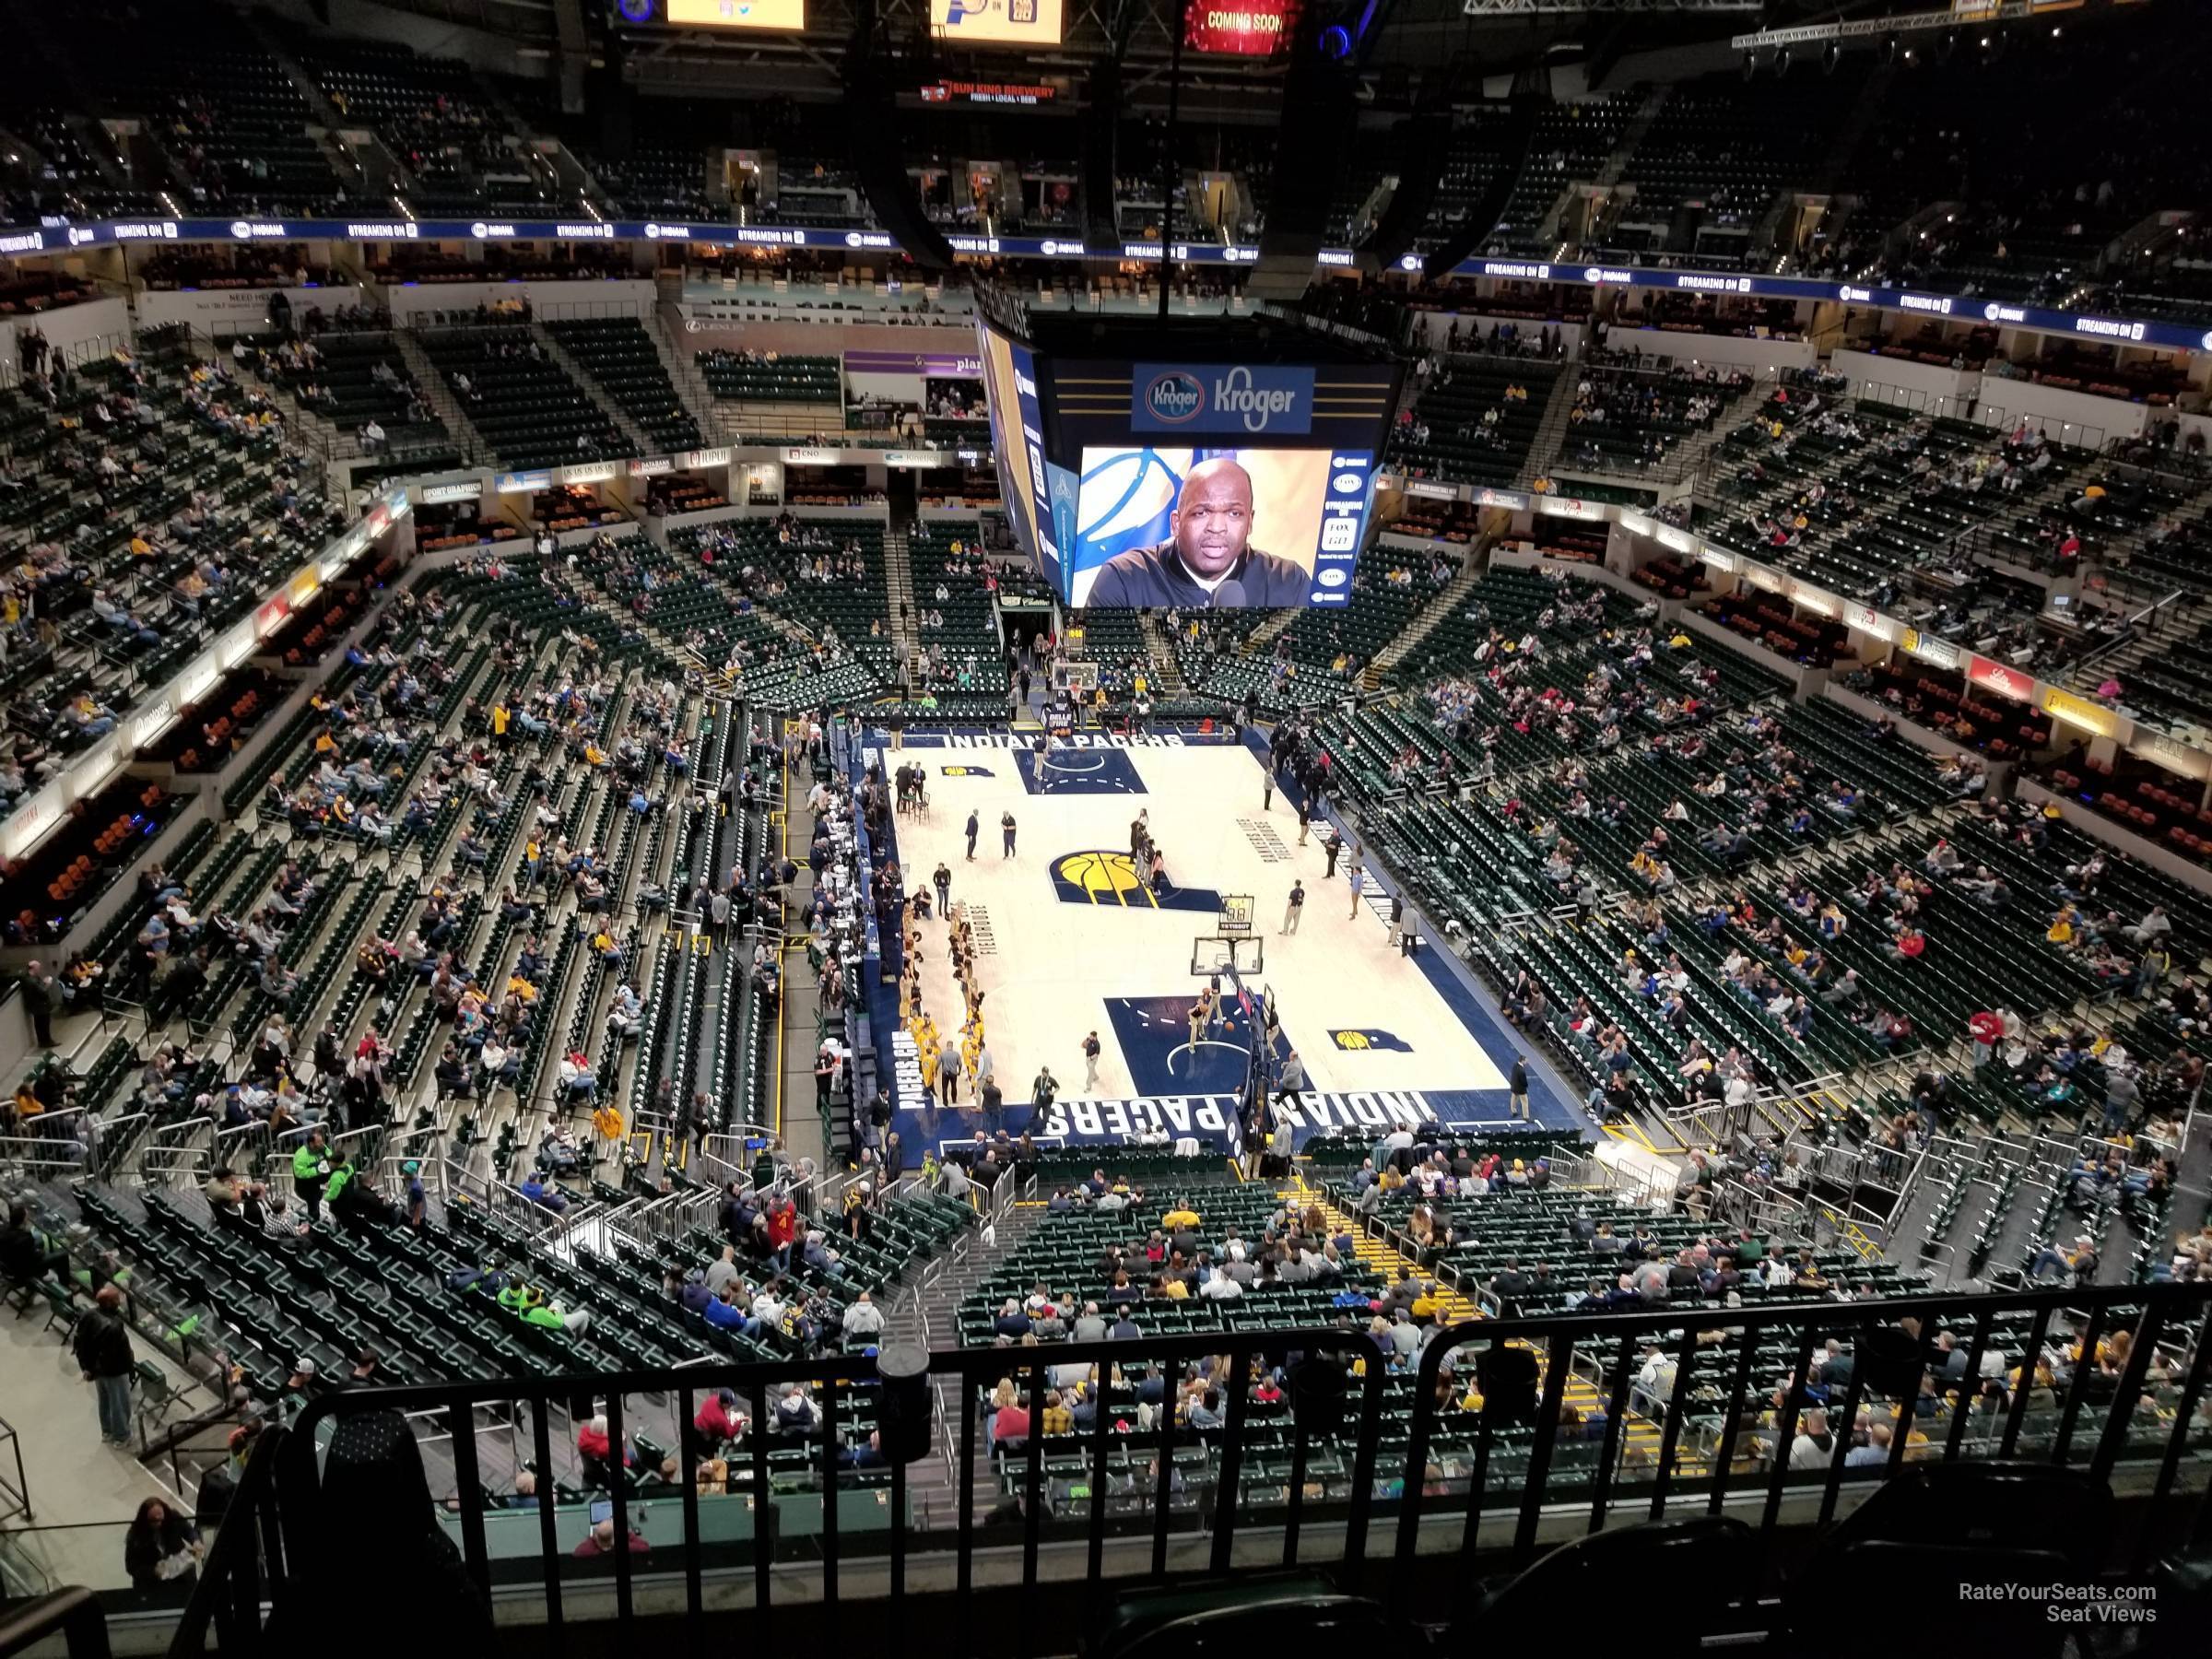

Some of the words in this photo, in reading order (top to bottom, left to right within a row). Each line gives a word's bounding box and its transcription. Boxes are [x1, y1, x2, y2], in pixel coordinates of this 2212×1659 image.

[1207, 11, 1251, 29] COMING
[1253, 13, 1283, 32] SOON
[953, 84, 974, 94] SUN
[976, 85, 1002, 95] KING
[1005, 85, 1054, 98] BREWERY
[995, 94, 1016, 103] LOCAL
[148, 225, 162, 237] ON
[347, 225, 394, 238] STREAMING
[394, 225, 406, 237] ON
[557, 225, 594, 237] STREAMING
[593, 226, 604, 238] ON
[737, 229, 782, 241] STREAMING
[782, 231, 793, 243] ON
[977, 240, 988, 251] ON
[1124, 245, 1163, 258] STREAMIN
[1485, 263, 1526, 276] STREAMING
[1525, 265, 1538, 277] ON
[1677, 276, 1726, 290] STREAMING
[1725, 278, 1737, 290] ON
[1900, 295, 1933, 311] STREAMING
[1932, 299, 1942, 312] ON
[2076, 318, 2120, 336] STREAMING
[2119, 324, 2132, 338] ON
[1154, 380, 1198, 416] Kroger
[1214, 366, 1296, 431] Kroger
[701, 450, 727, 462] IUPUI
[801, 450, 819, 458] CNO
[906, 453, 939, 463] Kinetico
[1330, 524, 1349, 532] FOX
[1073, 735, 1185, 749] PACERS
[1045, 1095, 1227, 1136] PACERS
